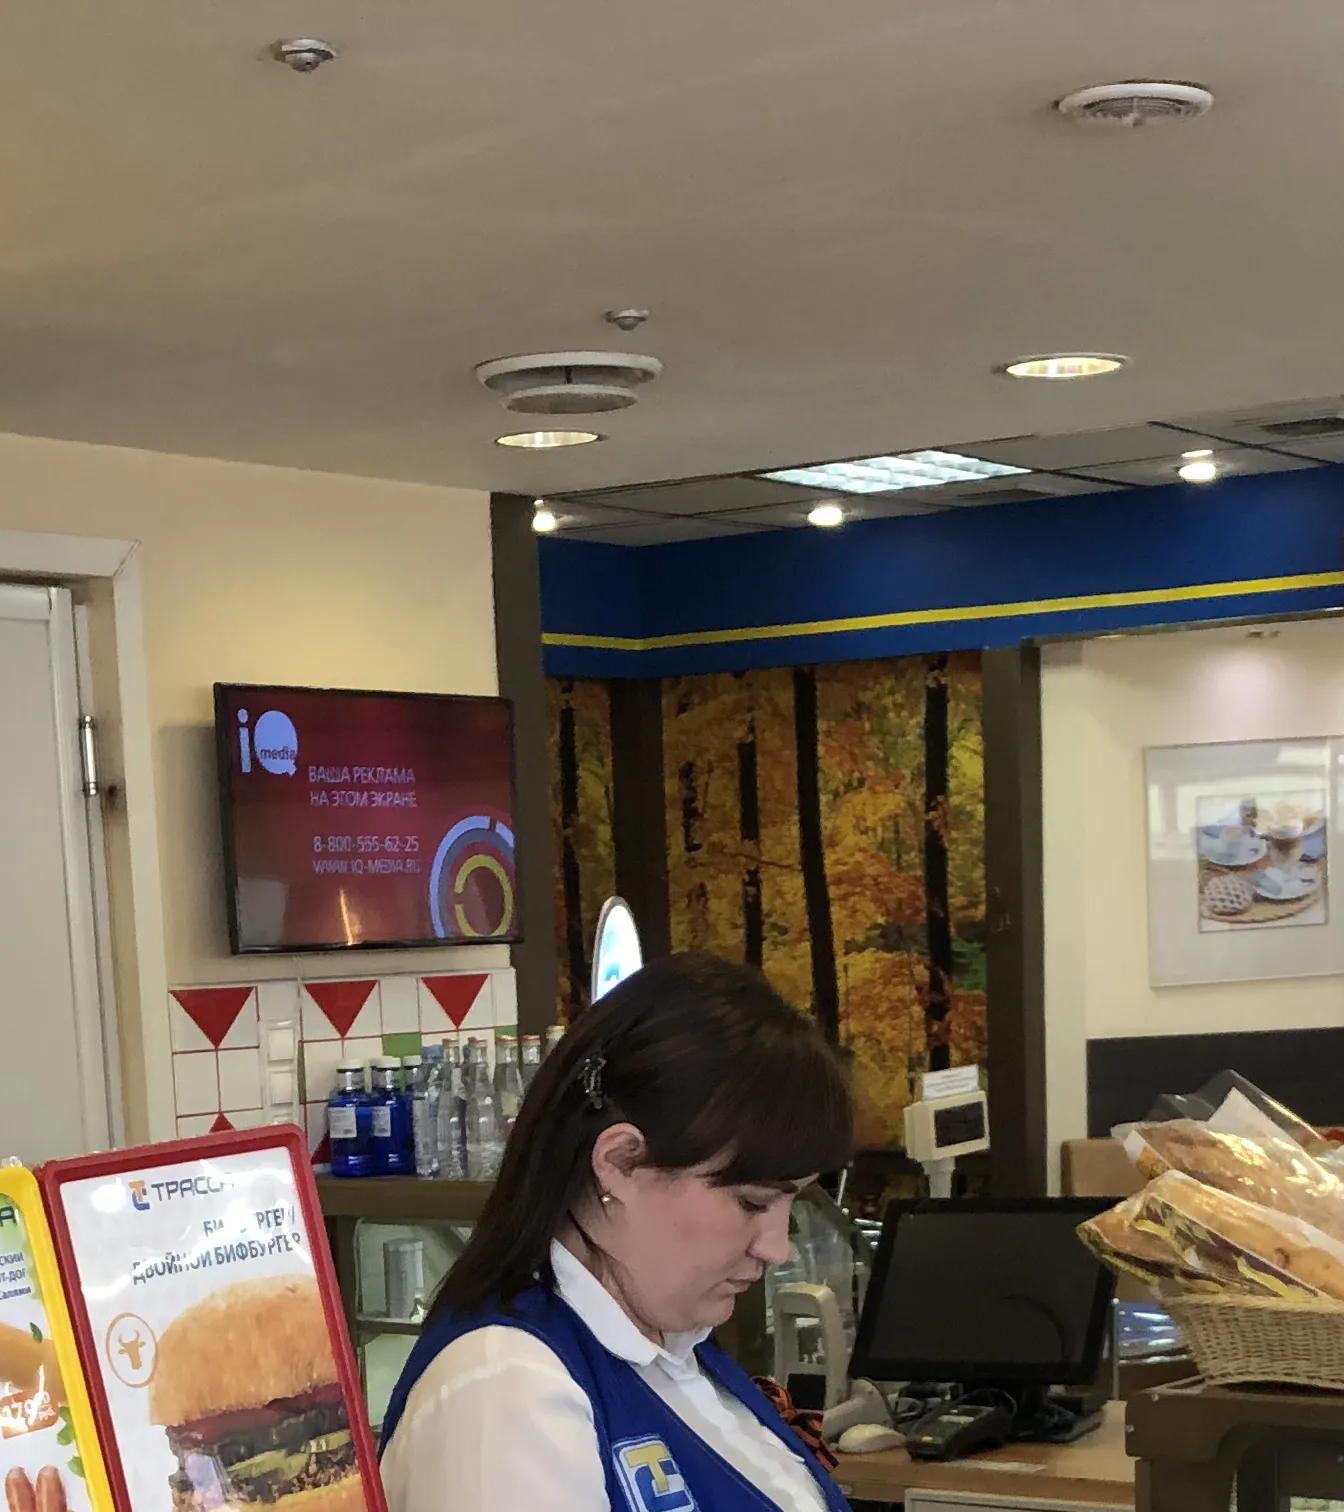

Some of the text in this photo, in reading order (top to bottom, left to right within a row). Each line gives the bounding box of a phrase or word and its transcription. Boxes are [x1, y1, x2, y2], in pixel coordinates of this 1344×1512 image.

[308, 765, 416, 784] ВАША РЕКЛАМА
[310, 791, 329, 807] НА
[370, 791, 417, 808] ЭКРАНЕ
